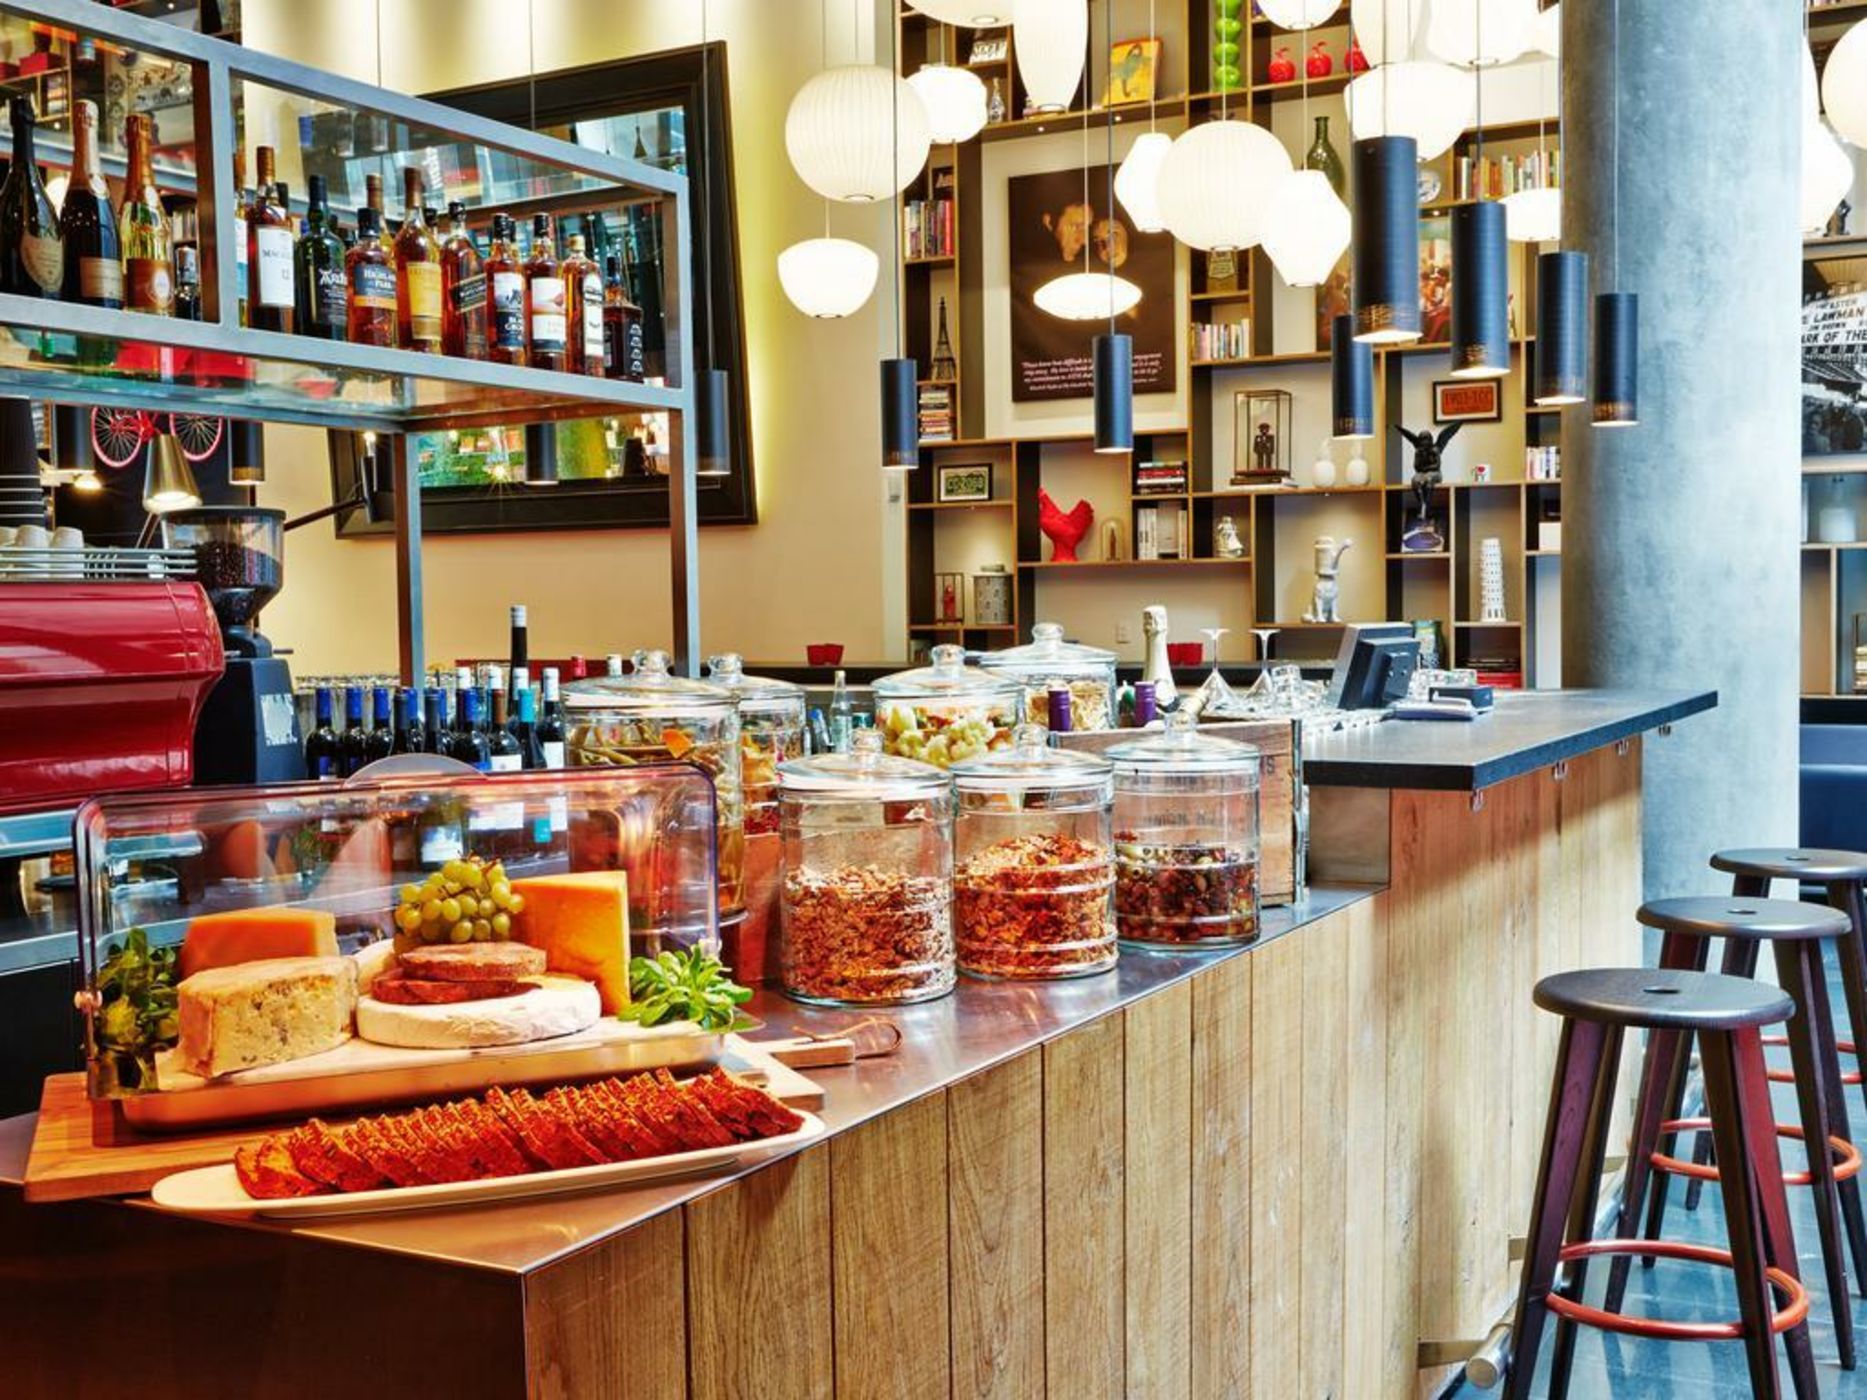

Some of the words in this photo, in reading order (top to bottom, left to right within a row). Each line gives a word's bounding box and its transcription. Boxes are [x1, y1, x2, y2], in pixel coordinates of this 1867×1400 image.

[1813, 306, 1865, 323] LAWMAN
[1823, 331, 1840, 343] OF
[1845, 329, 1867, 341] THE
